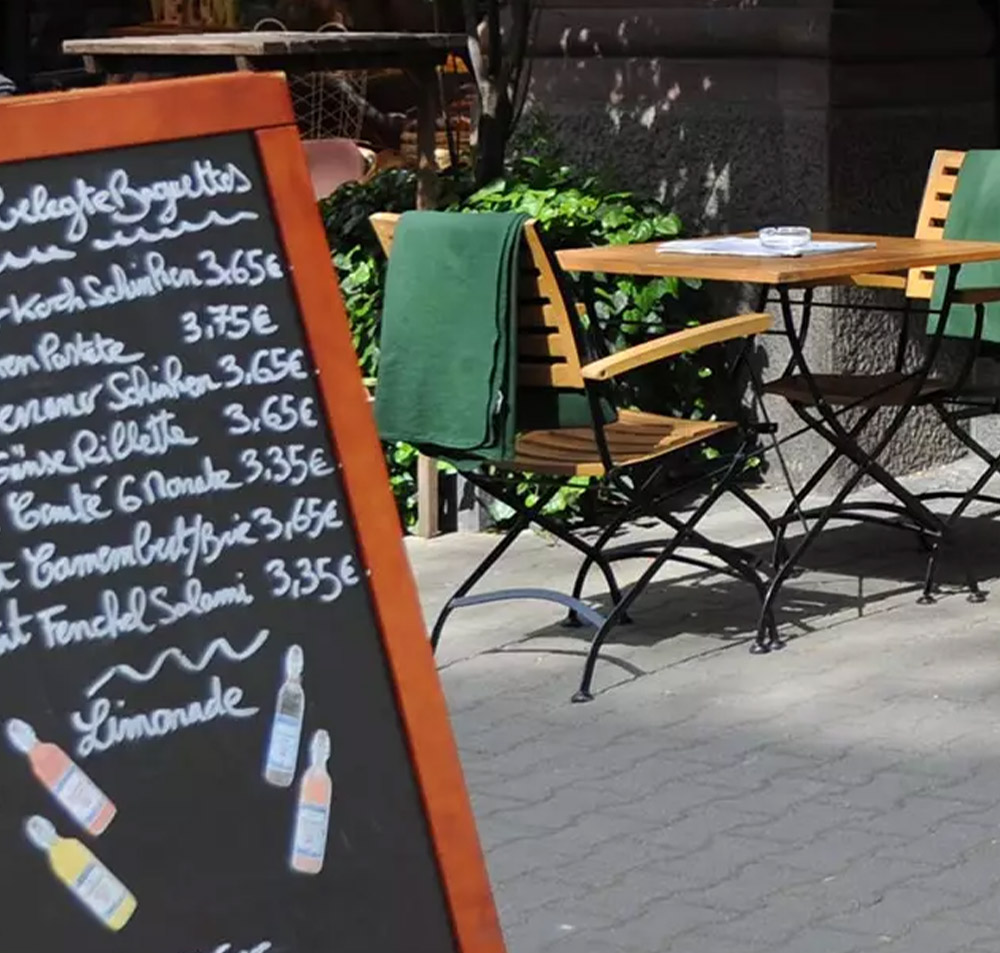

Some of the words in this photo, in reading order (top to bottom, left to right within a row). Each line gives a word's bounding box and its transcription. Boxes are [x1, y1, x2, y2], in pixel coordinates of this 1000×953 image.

[72, 409, 199, 469] Rillette
[117, 474, 142, 512] 6
[36, 586, 156, 648] Fenchel
[150, 571, 254, 625] Salami
[71, 675, 260, 757] Limonade
